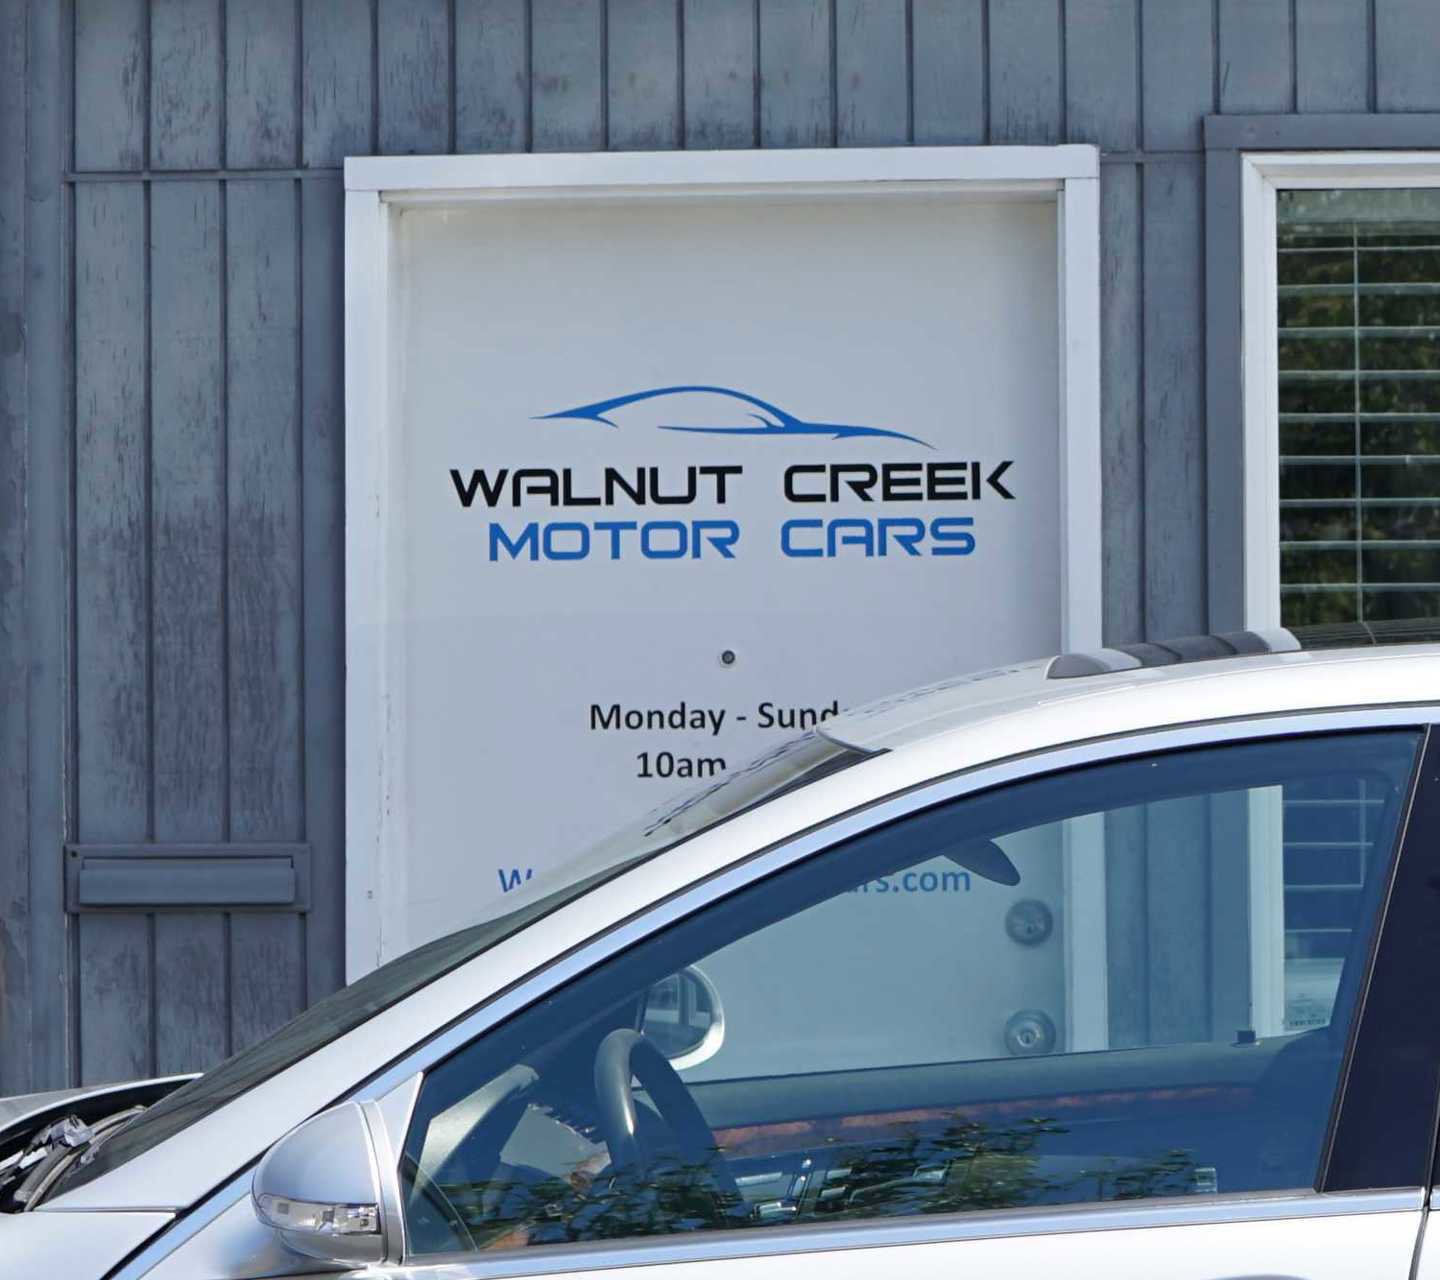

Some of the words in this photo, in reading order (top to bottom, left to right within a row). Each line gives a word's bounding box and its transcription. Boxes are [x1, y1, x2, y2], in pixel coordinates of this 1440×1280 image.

[449, 465, 743, 508] WALNUT
[784, 460, 1016, 503] CREEK
[489, 520, 740, 562] MOTOR
[781, 516, 976, 558] CARS
[589, 701, 726, 736] Monday
[757, 700, 839, 730] Sund
[636, 751, 727, 778] 10am
